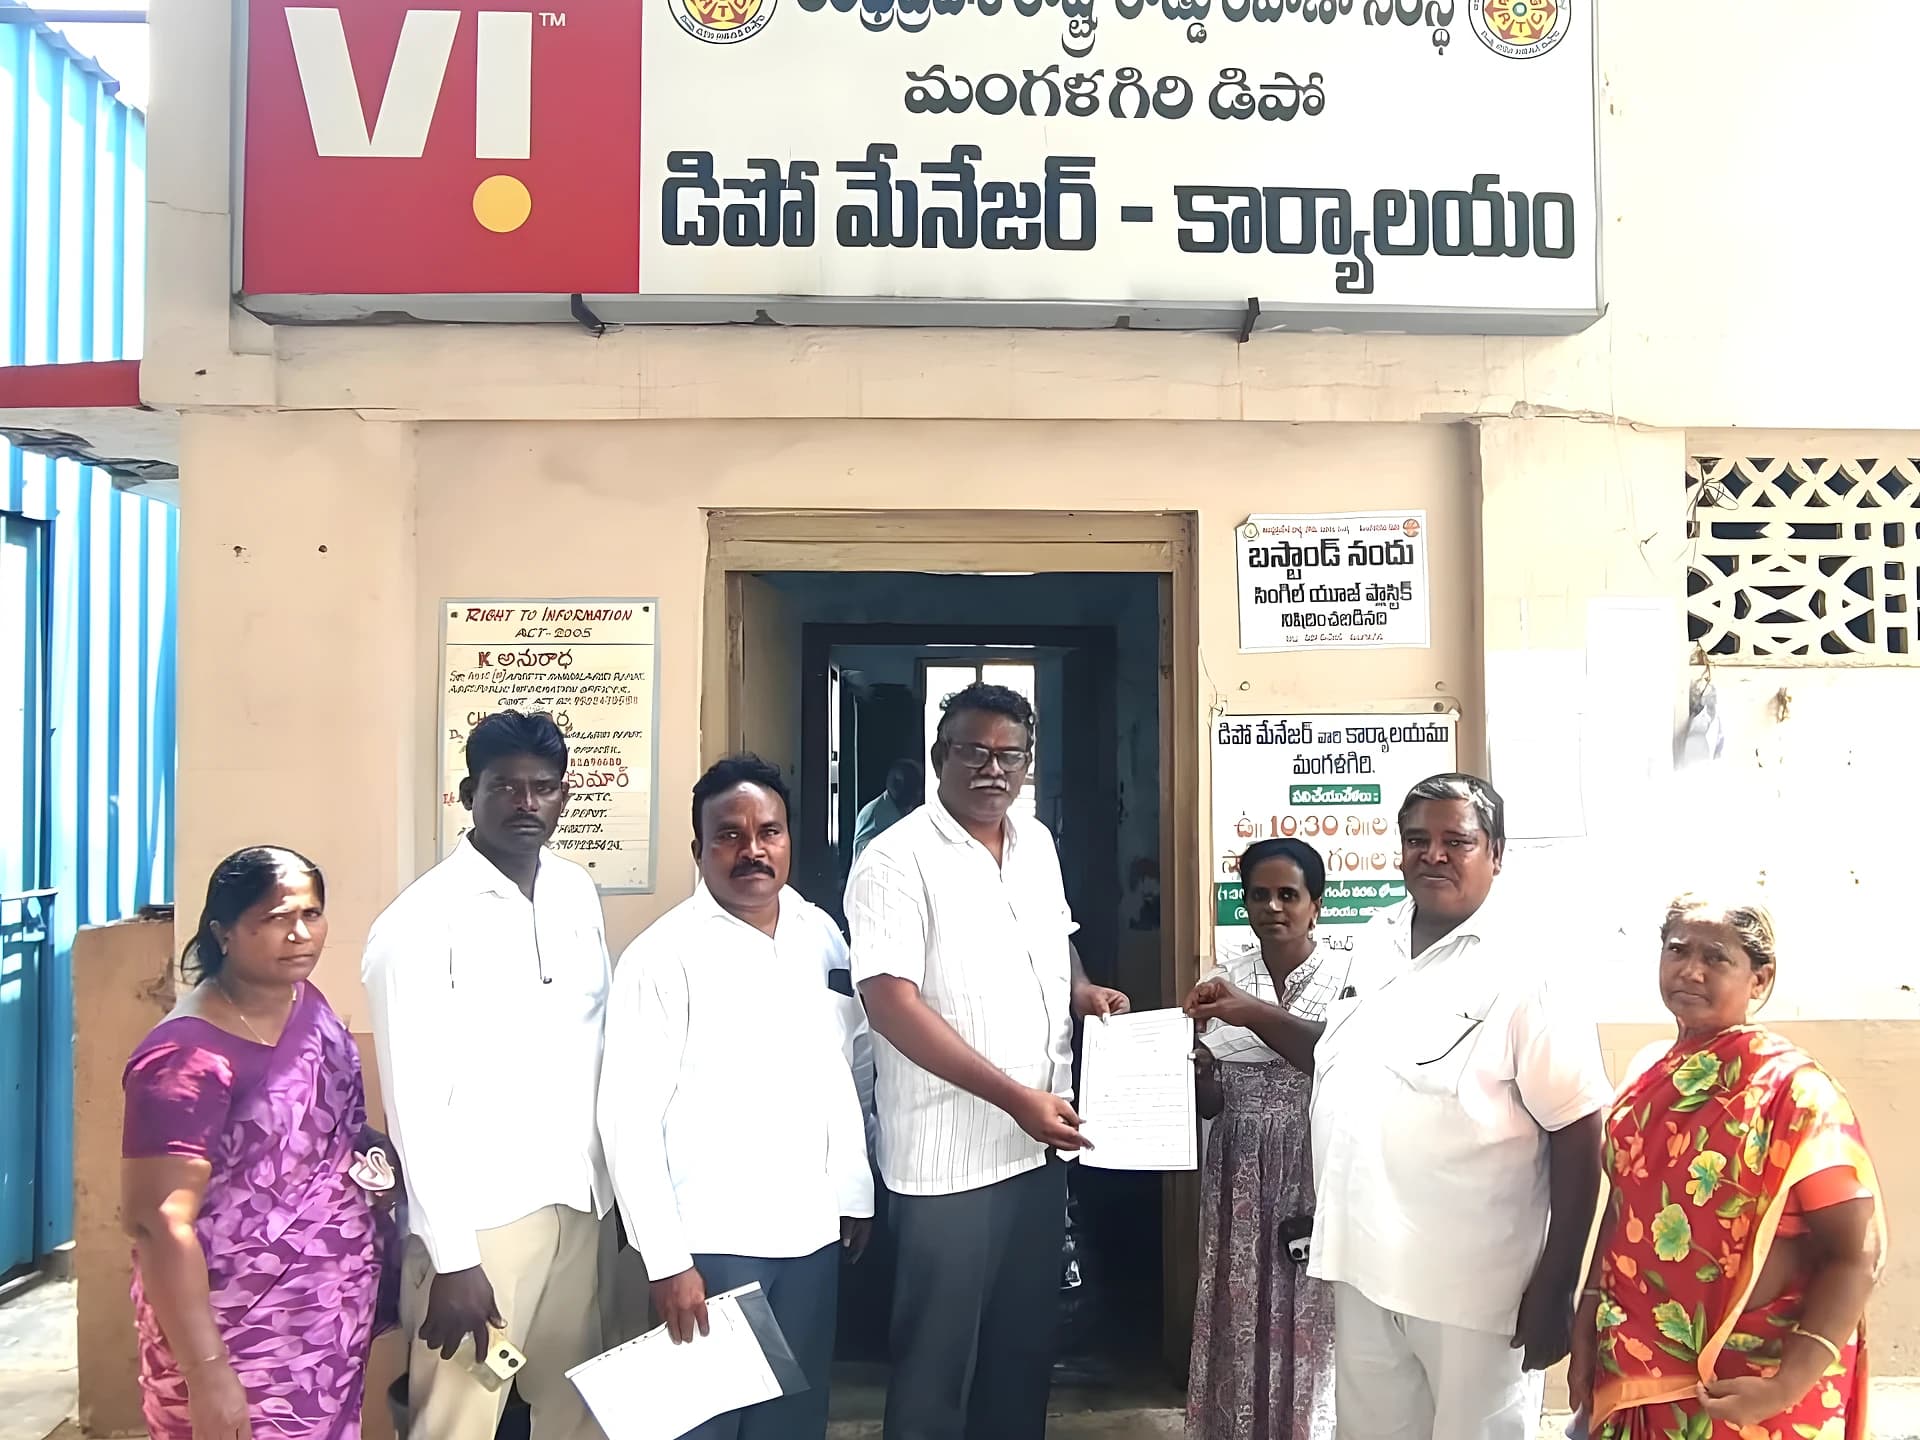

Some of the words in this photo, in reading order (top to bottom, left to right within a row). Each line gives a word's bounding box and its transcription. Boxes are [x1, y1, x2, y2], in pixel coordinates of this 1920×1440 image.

[1208, 67, 1326, 121] డిపో
[661, 150, 820, 248] డిపో
[835, 142, 1098, 250] మేనేజర్
[1173, 173, 1576, 294] కార్యాలయం
[1218, 722, 1252, 745] డిపో
[1256, 720, 1312, 745] మేనేజర్
[1270, 815, 1338, 837] 10:30
